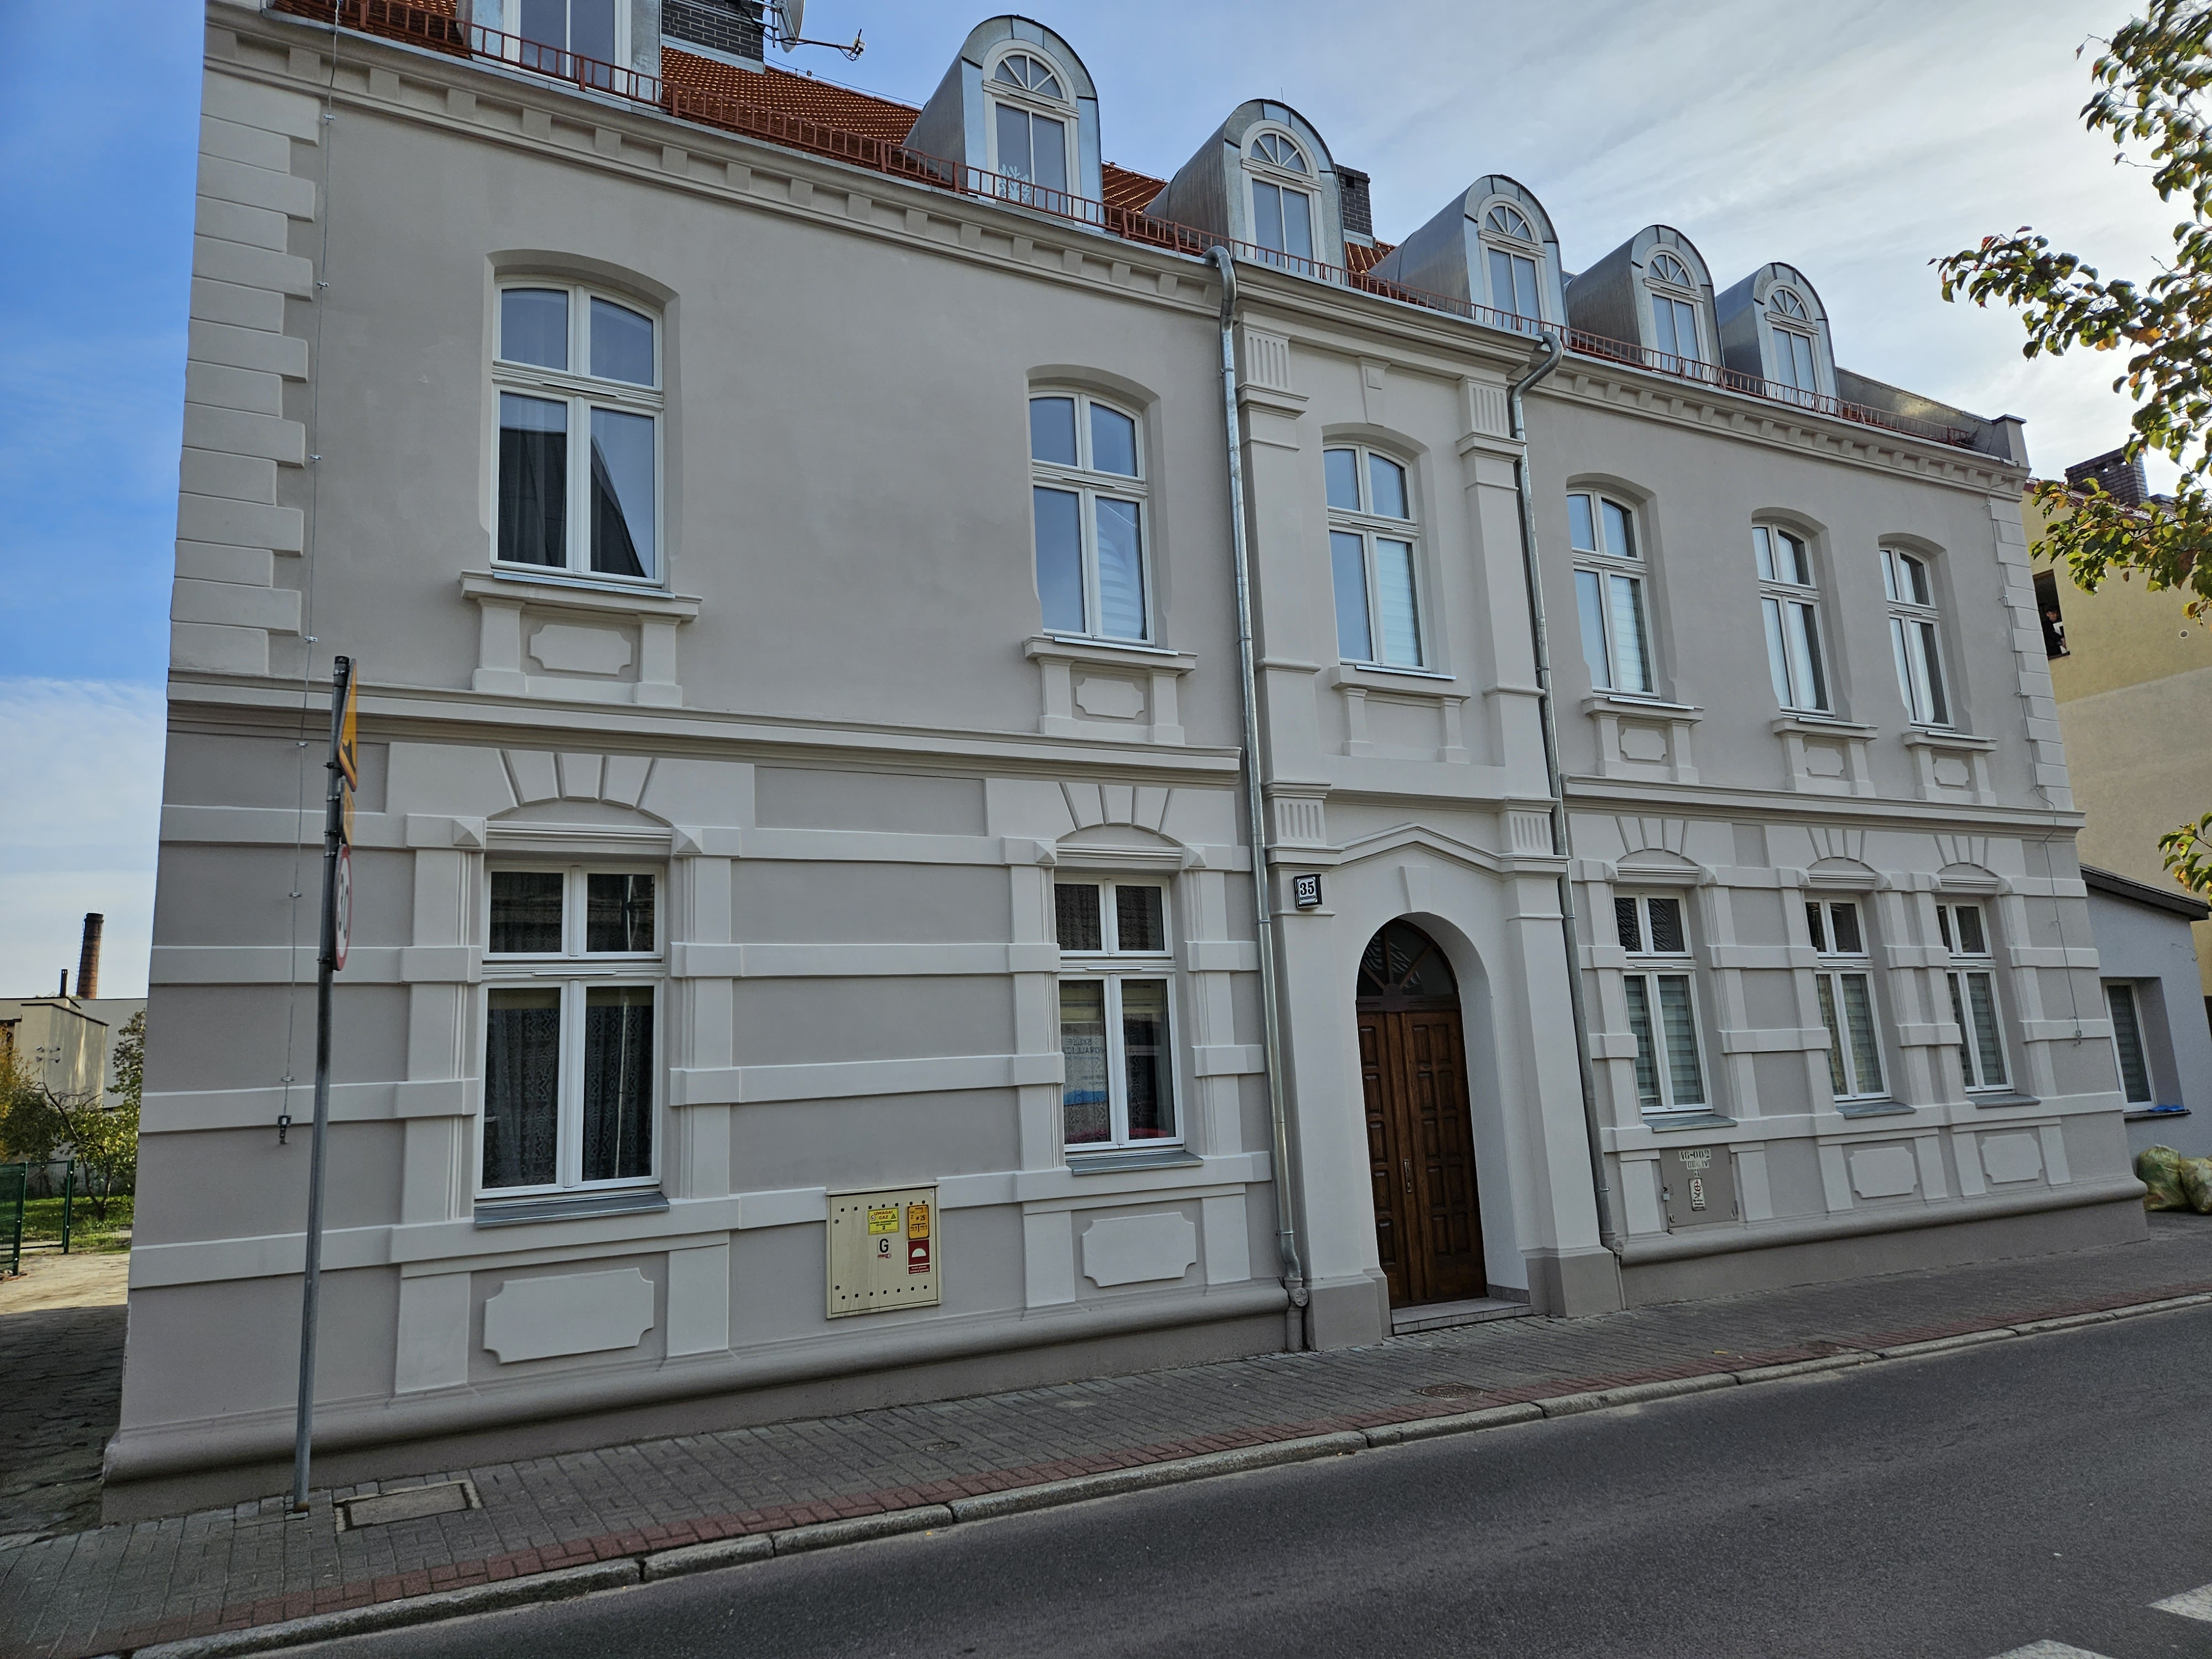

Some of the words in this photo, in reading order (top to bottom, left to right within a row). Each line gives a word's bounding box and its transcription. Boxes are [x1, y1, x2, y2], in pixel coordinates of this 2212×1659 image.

[1300, 881, 1314, 895] 35
[338, 873, 349, 940] 30
[879, 1238, 889, 1253] G
